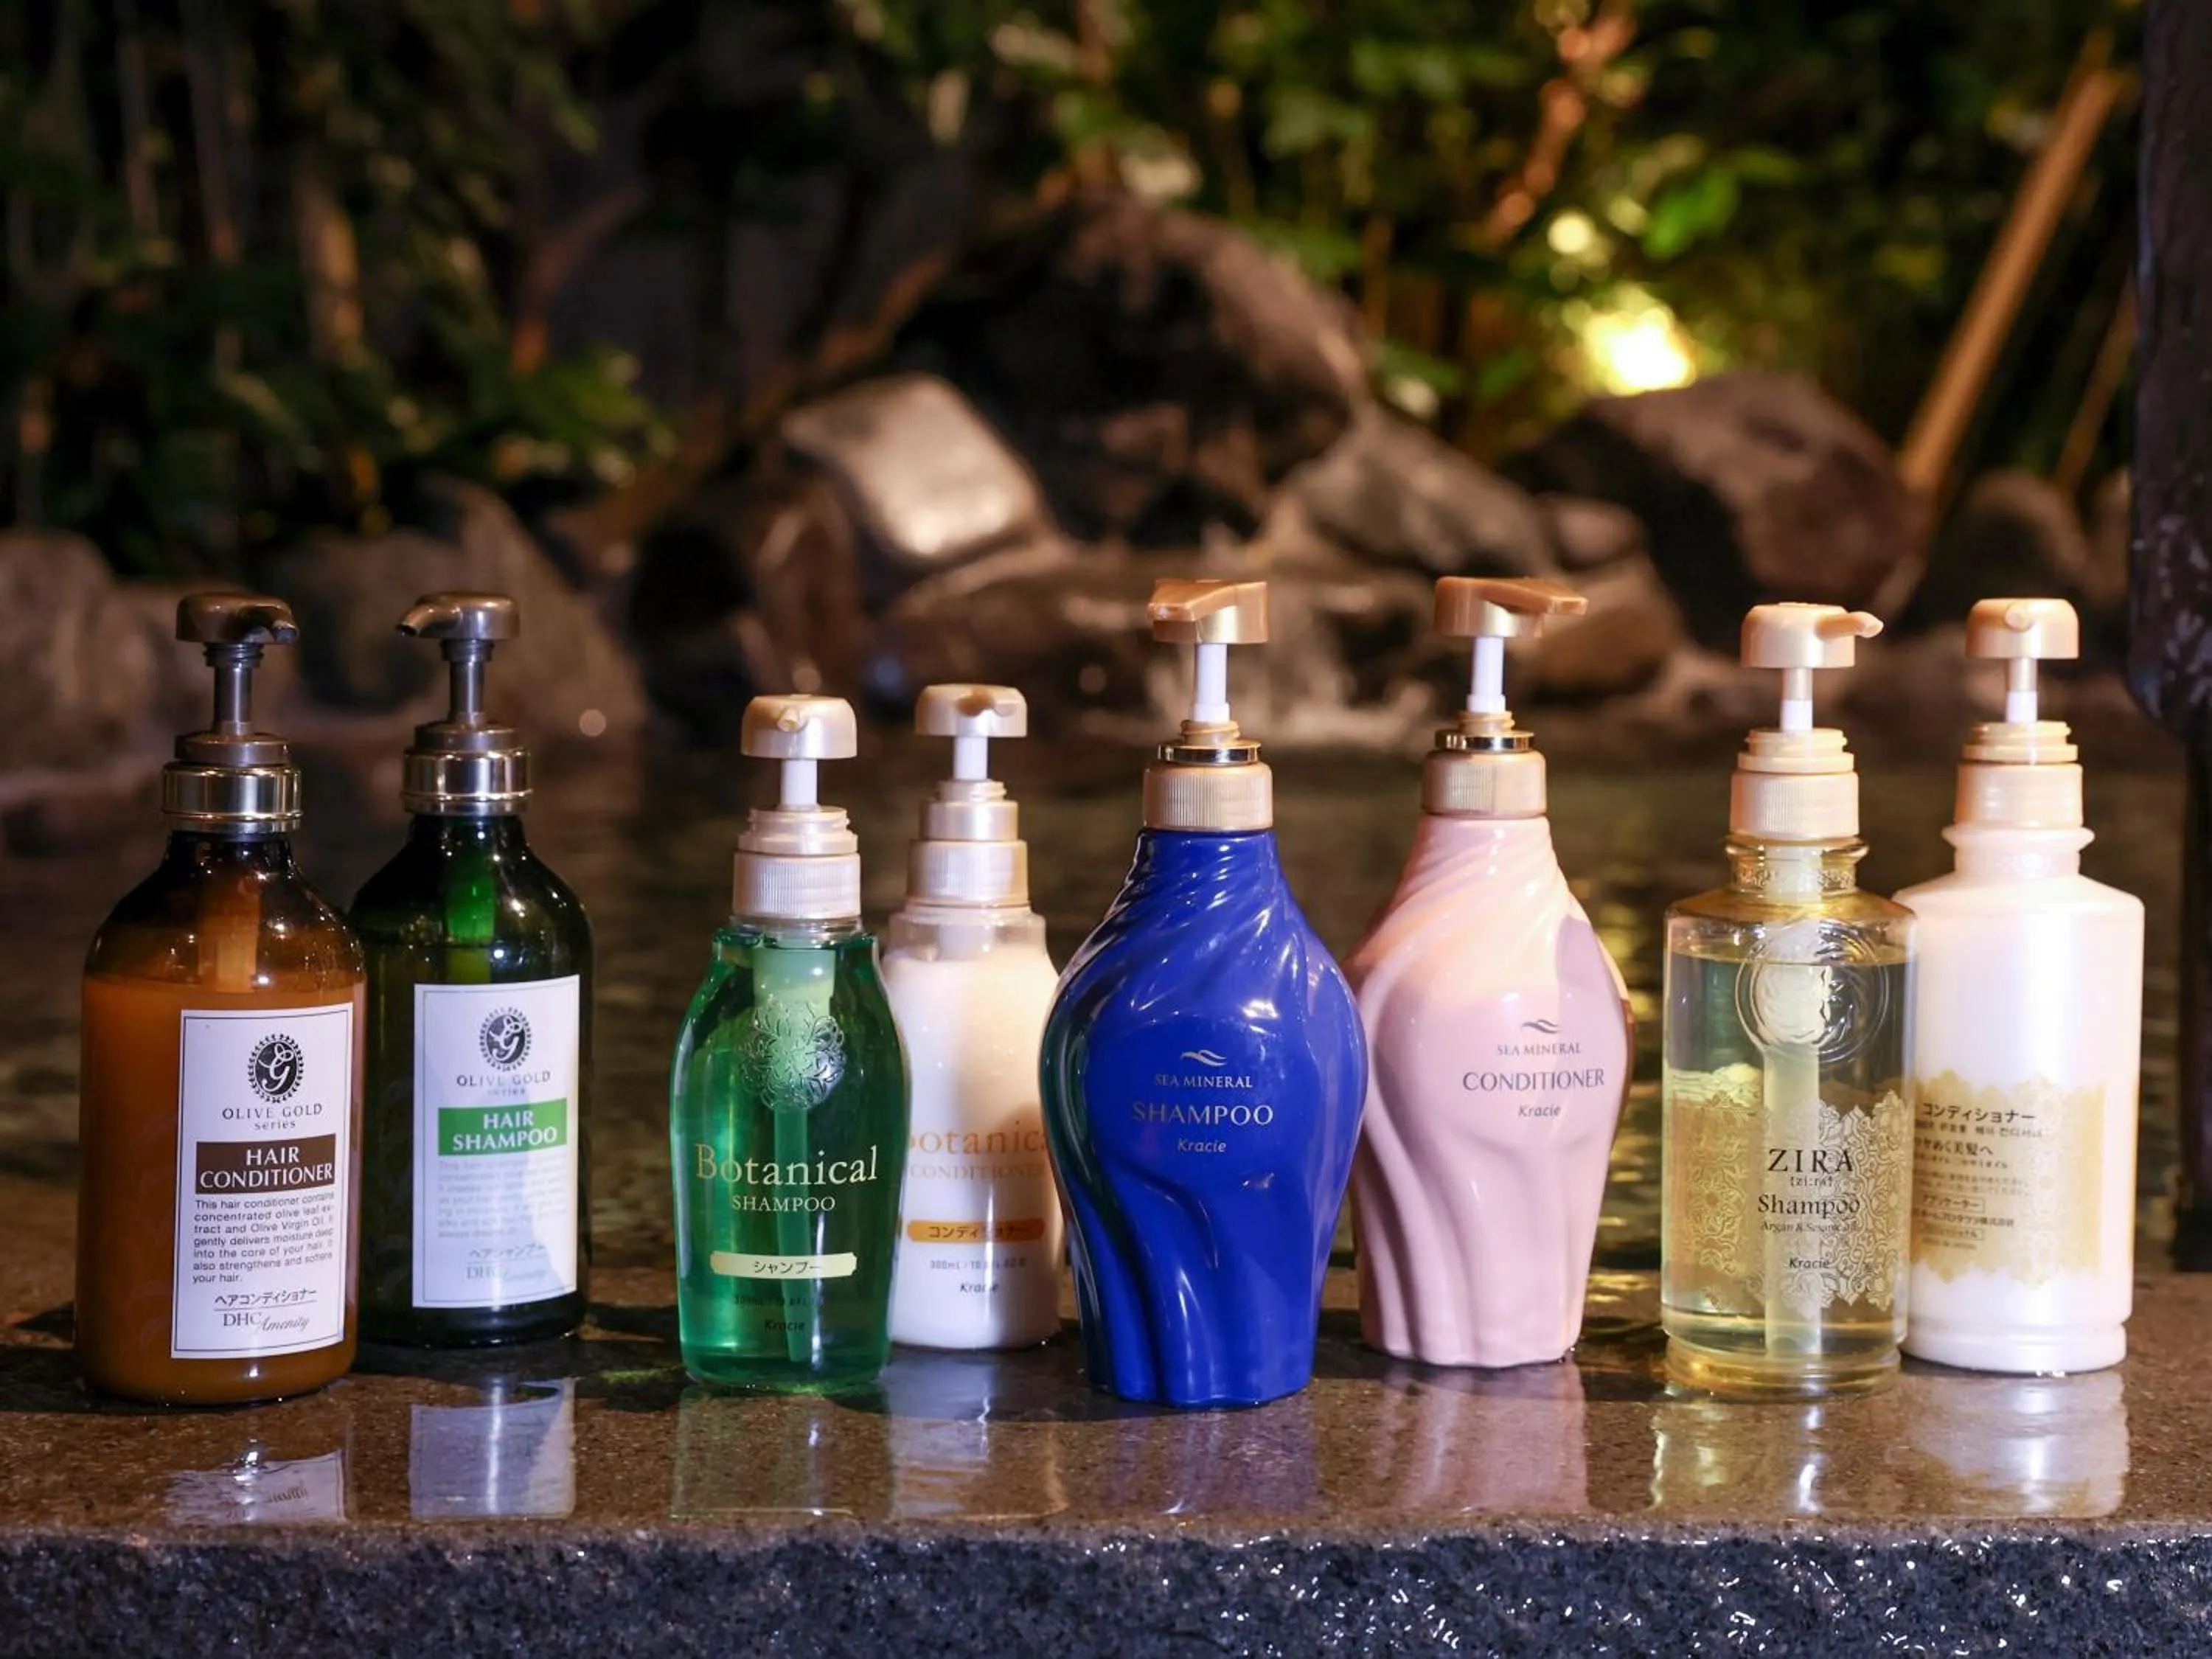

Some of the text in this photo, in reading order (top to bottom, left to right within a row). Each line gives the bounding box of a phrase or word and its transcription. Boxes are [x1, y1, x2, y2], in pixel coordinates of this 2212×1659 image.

[1497, 1042, 1581, 1056] SEA MINERAL
[512, 1071, 551, 1085] GOLD
[1154, 1074, 1253, 1088] SEA MINERAL
[1463, 1068, 1604, 1091] CONDITIONER
[222, 1102, 322, 1120] OLIVE GOLD
[1132, 1102, 1274, 1126] SHAMPOO
[1518, 1104, 1562, 1117] Kracie
[1921, 1102, 2036, 1123] コンディショナー
[254, 1120, 296, 1130] series
[483, 1110, 534, 1130] HAIR
[453, 1126, 557, 1152] SHAMPOO
[1178, 1138, 1226, 1152] Kracie
[246, 1147, 299, 1166] HAIR
[695, 1144, 878, 1186] Botanical
[1767, 1149, 1854, 1174] ZIRA
[200, 1163, 333, 1189] CONDITIONER
[195, 1200, 218, 1210] This
[220, 1199, 240, 1209] hair
[244, 1197, 299, 1208] conditioner
[731, 1194, 835, 1211] SHAMPOO
[1757, 1194, 1860, 1220] Shampoo
[194, 1211, 271, 1222] concentrated
[276, 1208, 299, 1219] olive
[194, 1224, 220, 1234] tract
[225, 1223, 246, 1234] and
[250, 1222, 278, 1232] Olive
[282, 1219, 310, 1230] Virgin
[194, 1237, 225, 1248] gently
[229, 1235, 271, 1245] delivers
[274, 1231, 313, 1242] moisture
[194, 1249, 215, 1259] into
[219, 1248, 237, 1258] the
[241, 1248, 266, 1257] core
[269, 1246, 280, 1255] of
[282, 1243, 305, 1256] your
[192, 1262, 215, 1271] also
[219, 1258, 282, 1272] strengthens
[284, 1256, 302, 1266] and
[754, 1261, 821, 1274] シャンプー
[1790, 1257, 1831, 1269] Kracie
[192, 1273, 243, 1284] your hair.
[214, 1288, 317, 1307] ヘアコンディショナー
[223, 1312, 310, 1331] DHC Amenity
